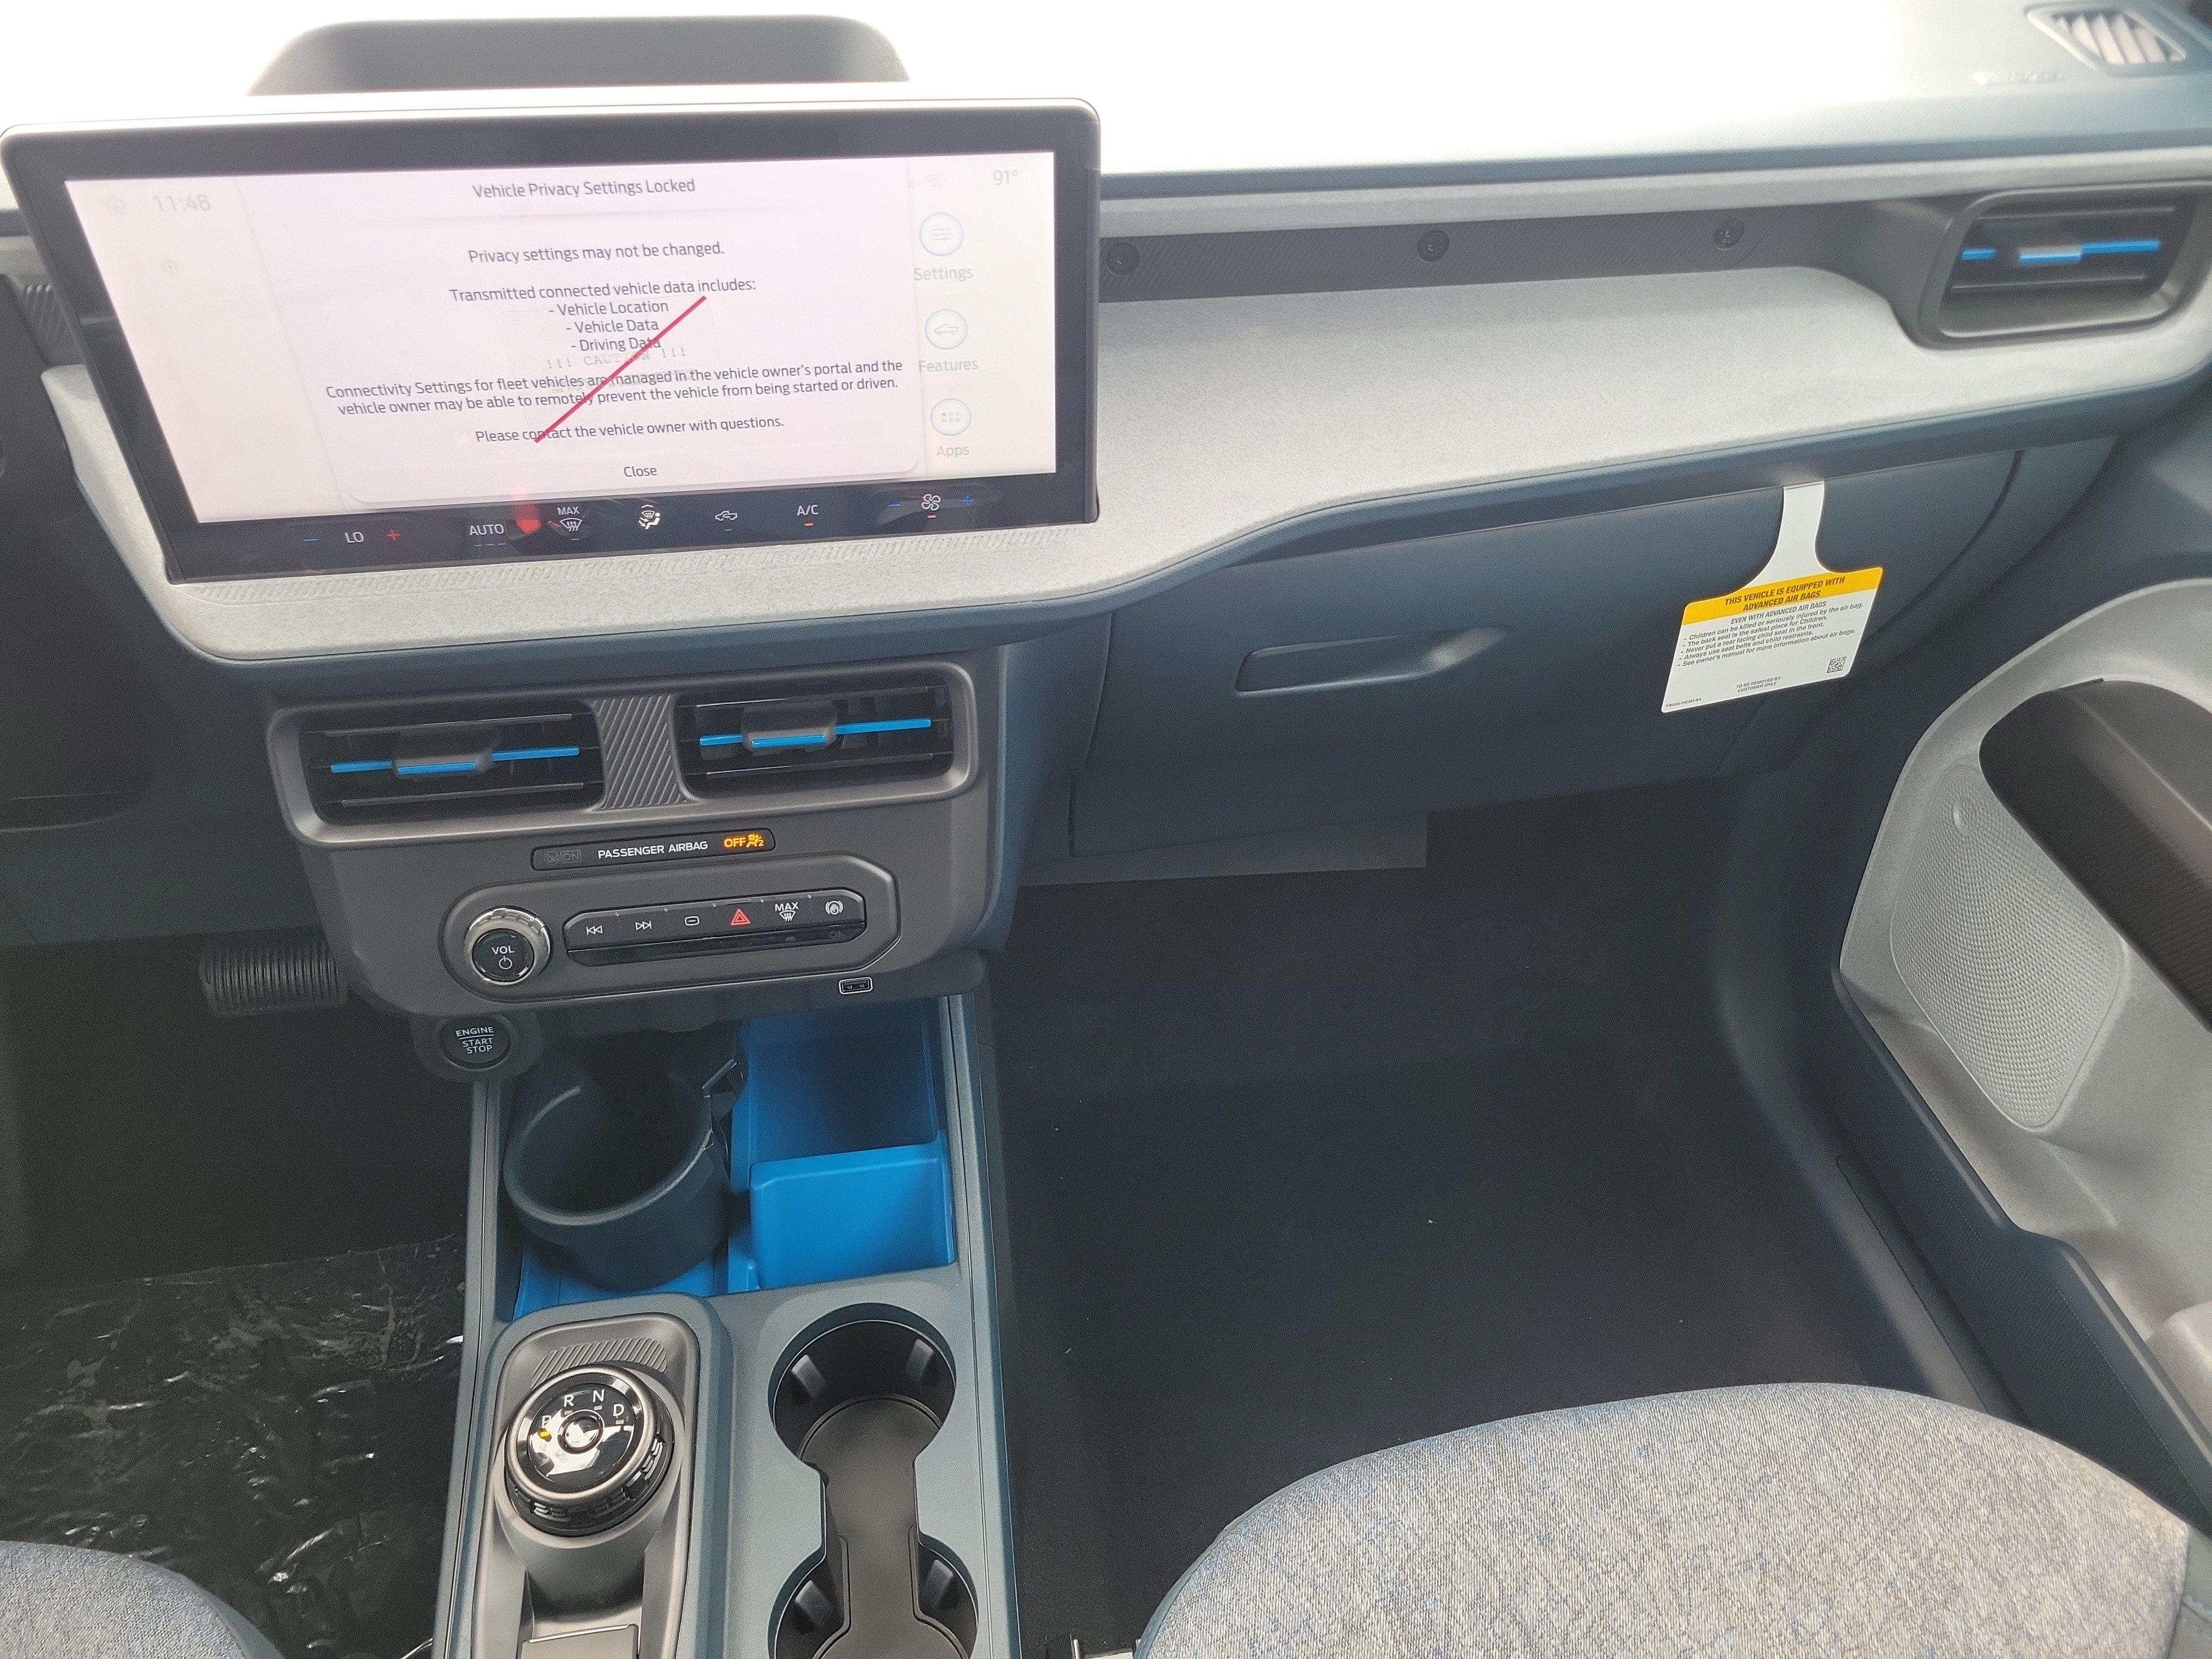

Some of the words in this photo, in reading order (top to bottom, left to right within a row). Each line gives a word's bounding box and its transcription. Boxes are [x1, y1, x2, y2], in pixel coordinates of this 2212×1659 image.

[993, 169, 1019, 187] 91°
[472, 183, 526, 198] Vehicle
[528, 183, 579, 198] Privacy
[583, 181, 643, 196] Settings
[646, 178, 696, 193] Locked
[154, 194, 210, 212] 11:48
[469, 250, 519, 264] Privacy
[523, 247, 579, 262] settings
[582, 249, 611, 261] may
[616, 245, 639, 258] not
[643, 244, 659, 257] be
[663, 241, 725, 257] changed.
[914, 266, 974, 282] Settings
[449, 286, 537, 302] Transmitted
[539, 283, 611, 298] connected
[613, 281, 661, 295] vehicle
[663, 281, 695, 294] data
[697, 278, 756, 292] includes:
[556, 302, 607, 316] Vehicle
[609, 300, 669, 314] Location
[574, 319, 624, 334] Vehicle
[627, 319, 659, 332] Data
[579, 338, 625, 352] Driving
[918, 359, 979, 373] Features
[326, 383, 411, 398] Connectivity
[415, 380, 472, 394] Settings
[474, 379, 494, 392] for
[496, 378, 529, 390] fleet
[531, 375, 584, 390] vehicles
[588, 376, 607, 386] are
[611, 370, 672, 385] managed
[675, 370, 687, 382] in
[690, 369, 712, 381] the
[714, 366, 759, 380] vehicle
[762, 364, 811, 377] owner's
[814, 362, 853, 377] portal
[855, 360, 879, 373] and
[881, 360, 902, 371] the
[337, 402, 387, 415] vehicle
[389, 402, 431, 413] owner
[433, 400, 462, 411] may
[465, 397, 484, 409] be
[486, 396, 515, 408] able
[517, 396, 532, 407] to
[535, 392, 593, 406] remotely
[598, 390, 647, 405] prevent
[651, 388, 672, 400] the
[674, 386, 719, 399] vehicle
[721, 385, 753, 397] from
[755, 382, 791, 396] being
[793, 379, 838, 393] started
[841, 381, 854, 391] or
[857, 377, 898, 390] driven.
[475, 430, 520, 442] Please
[574, 426, 597, 437] the
[599, 423, 644, 436] vehicle
[647, 423, 686, 434] owner
[689, 419, 718, 431] with
[720, 417, 785, 431] questions.
[936, 444, 969, 458] Apps
[624, 466, 657, 477] Close
[557, 506, 580, 515] MAX
[797, 504, 819, 516] A/C
[470, 523, 505, 536] AUTO
[345, 532, 364, 544] LO
[1725, 596, 1742, 606] THIS
[1744, 590, 1775, 602] VEHICLE
[1786, 581, 1824, 594] EQUIPPED
[1825, 577, 1845, 586] WITH
[1742, 598, 1784, 612] ADVANCED
[1784, 595, 1799, 604] AIR
[1799, 591, 1821, 600] BAGS
[1731, 616, 1747, 625] EVEN
[1748, 613, 1764, 621] WITH
[1764, 606, 1797, 618] ADVANCED
[1809, 601, 1827, 610] BAGS
[1689, 631, 1716, 640] Children
[1739, 622, 1757, 630] killed
[1765, 615, 1795, 627] seriously
[1796, 610, 1819, 621] injured
[1750, 625, 1770, 634] safest
[1770, 623, 1788, 633] place
[1799, 616, 1827, 625] Children.
[1705, 642, 1717, 651] put
[1736, 635, 1756, 646] facing
[1807, 622, 1824, 630] front.
[1684, 651, 1707, 662] Always
[1782, 631, 1814, 641] restraints.
[1696, 654, 1721, 664] owner's
[1721, 649, 1745, 659] manual
[1773, 637, 1809, 648] information
[1810, 633, 1829, 641] about
[1737, 684, 1764, 693] CUSTOMER
[1750, 678, 1774, 687] REMOVED
[598, 845, 664, 859] PASSENGER
[668, 841, 708, 853] AIRBAG
[724, 837, 746, 848] OFF
[775, 901, 799, 912] MAX
[491, 945, 515, 955] VOL
[455, 1026, 494, 1037] ENGINE
[462, 1037, 493, 1047] START
[466, 1045, 493, 1054] STOP
[563, 1394, 574, 1407] R
[592, 1389, 605, 1403] N
[613, 1403, 624, 1417] D
[541, 1415, 552, 1427] P
